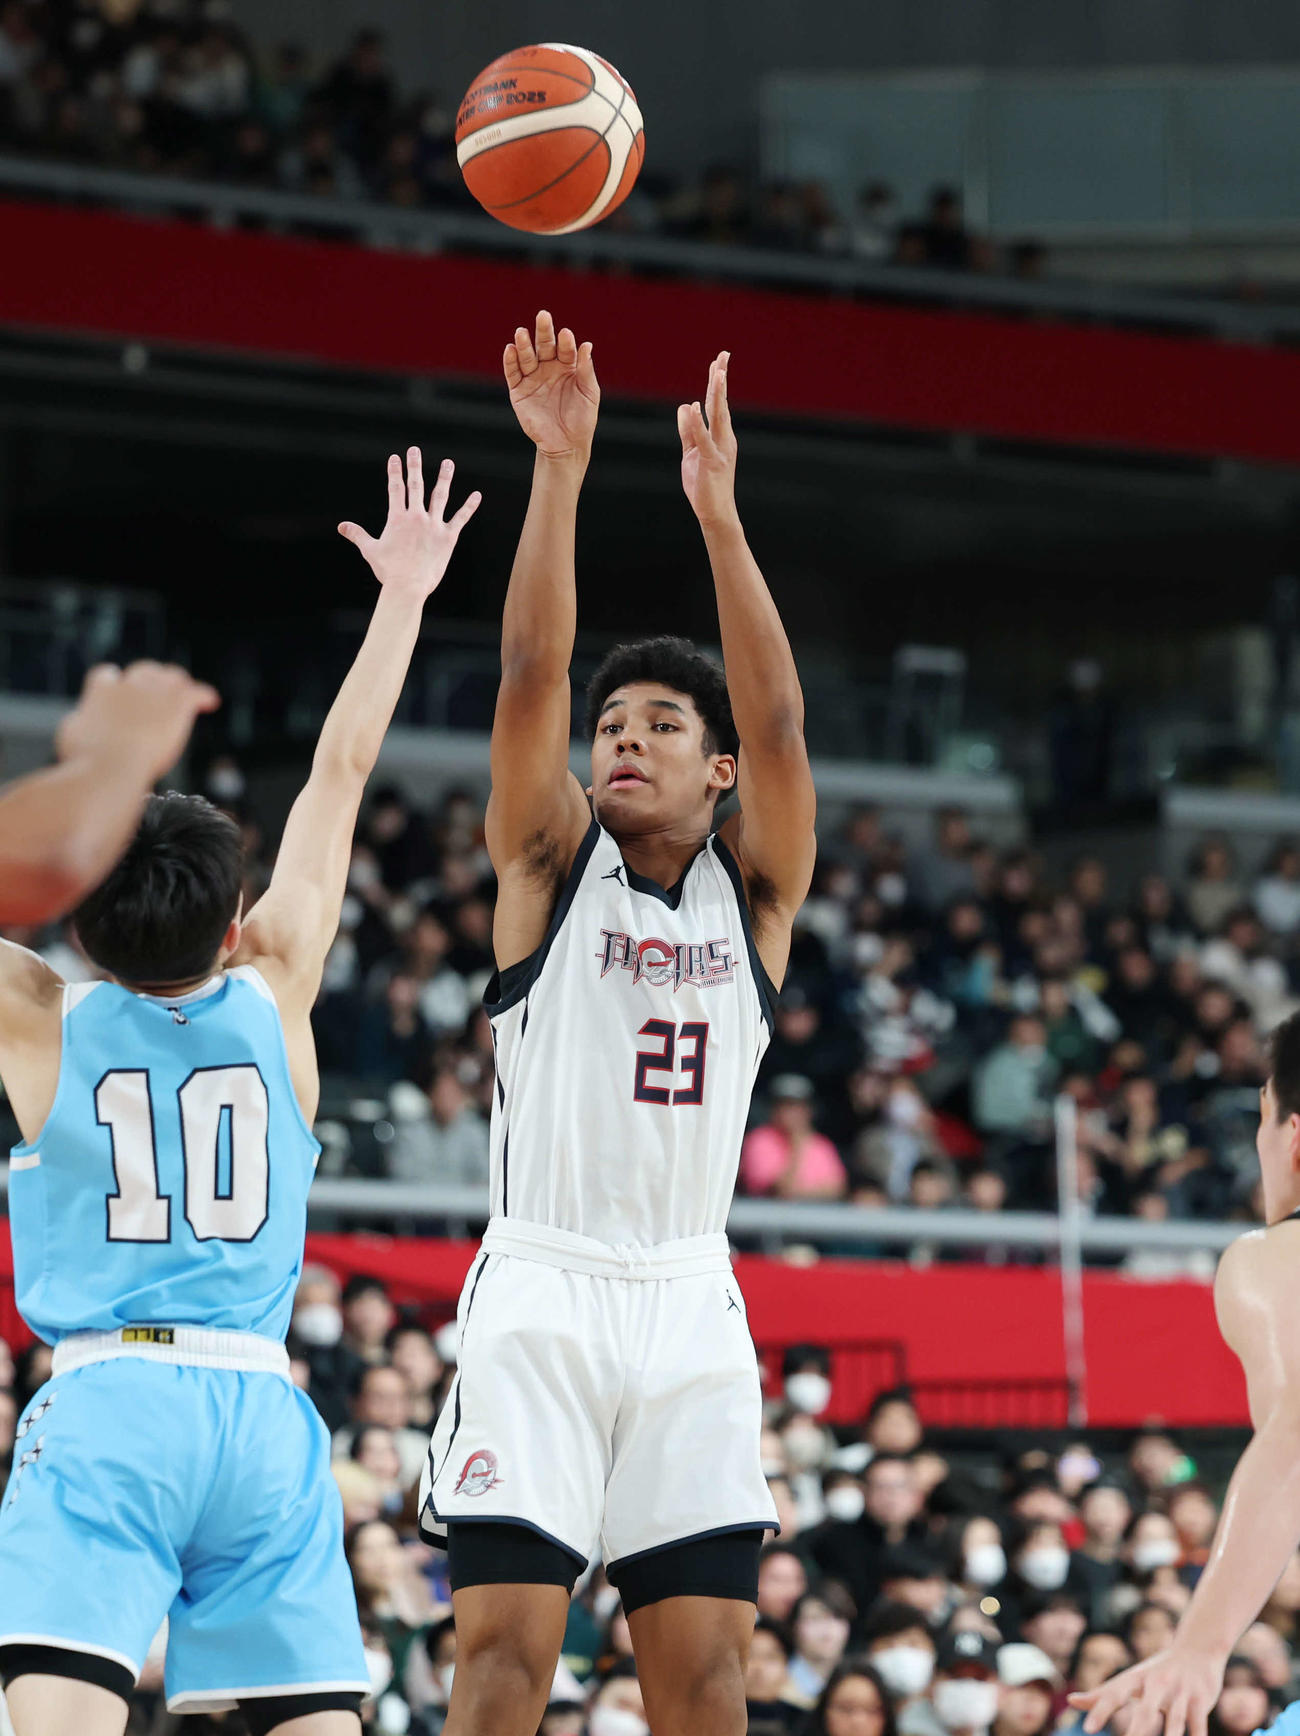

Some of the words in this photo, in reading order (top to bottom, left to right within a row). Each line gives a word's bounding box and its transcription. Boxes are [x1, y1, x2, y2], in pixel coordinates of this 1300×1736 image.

[506, 90, 546, 105] 2025
[633, 1018, 709, 1106] 23
[93, 1062, 270, 1244] 10
